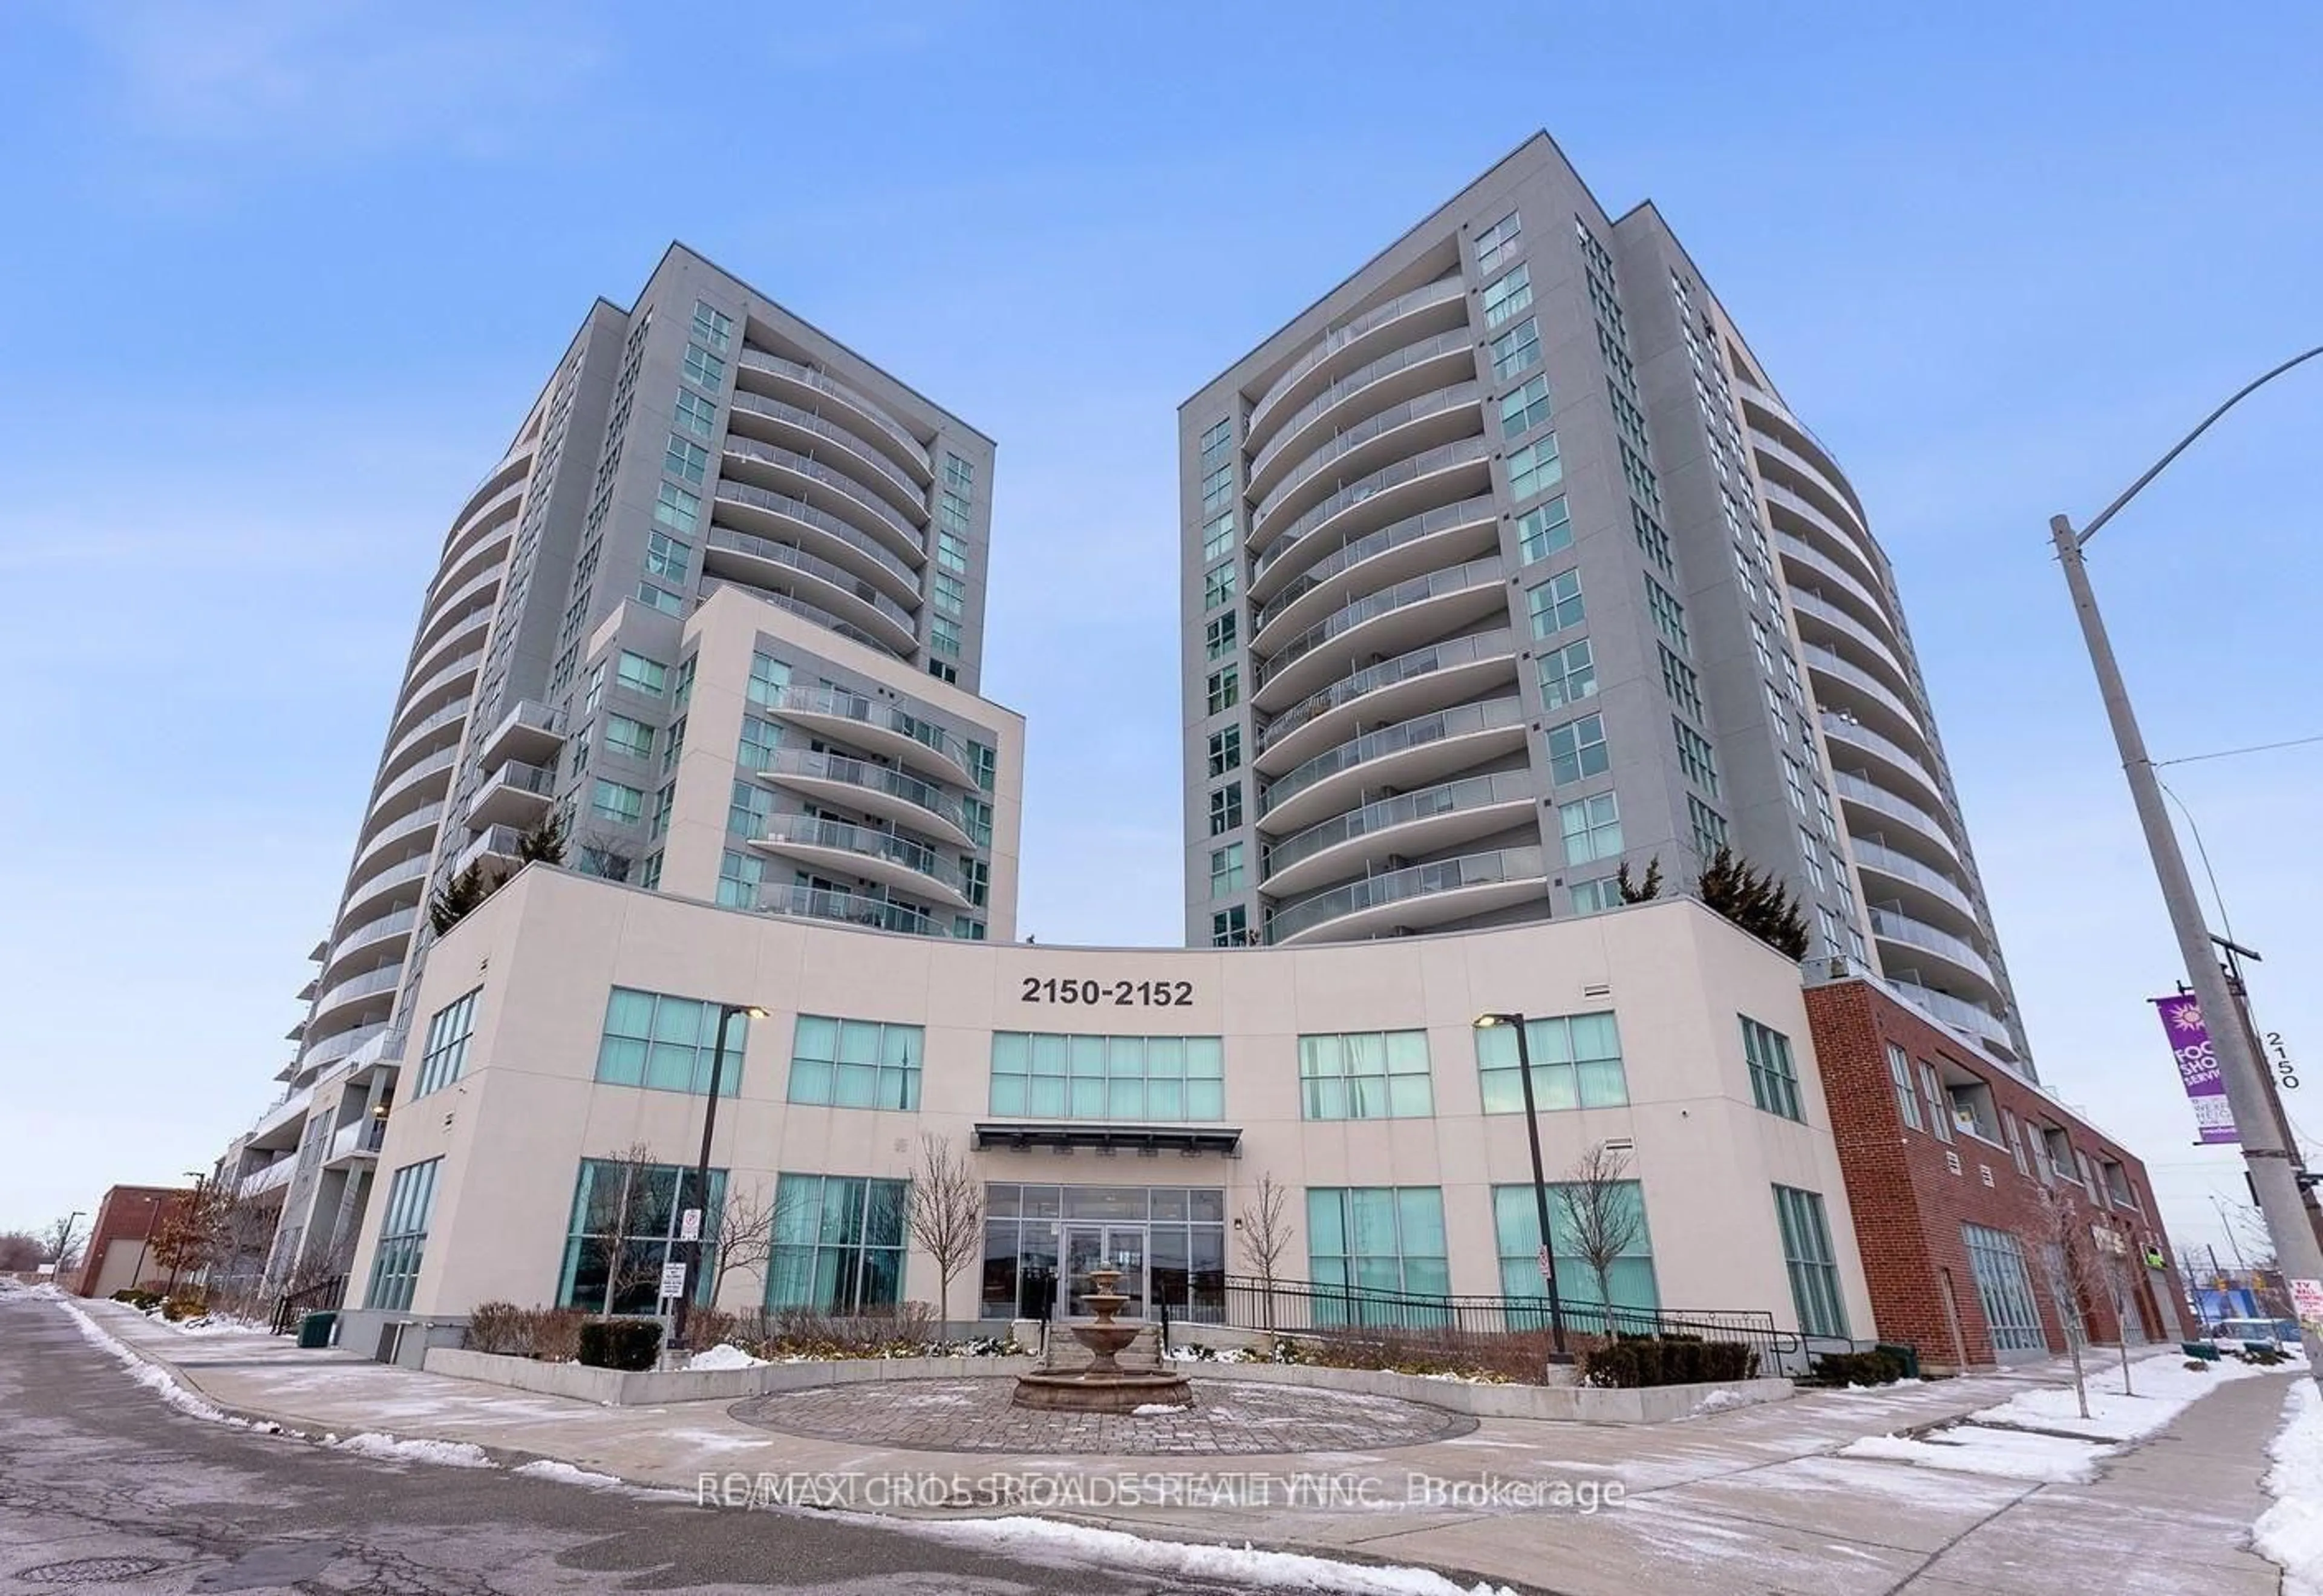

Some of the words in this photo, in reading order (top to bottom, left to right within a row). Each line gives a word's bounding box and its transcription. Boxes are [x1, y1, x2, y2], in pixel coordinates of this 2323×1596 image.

[1021, 978, 1192, 1006] 2150-2152
[2175, 1041, 2215, 1063] FOO
[2267, 1032, 2299, 1088] 2150
[2180, 1056, 2218, 1075] SHO
[2184, 1068, 2221, 1087] SERVI
